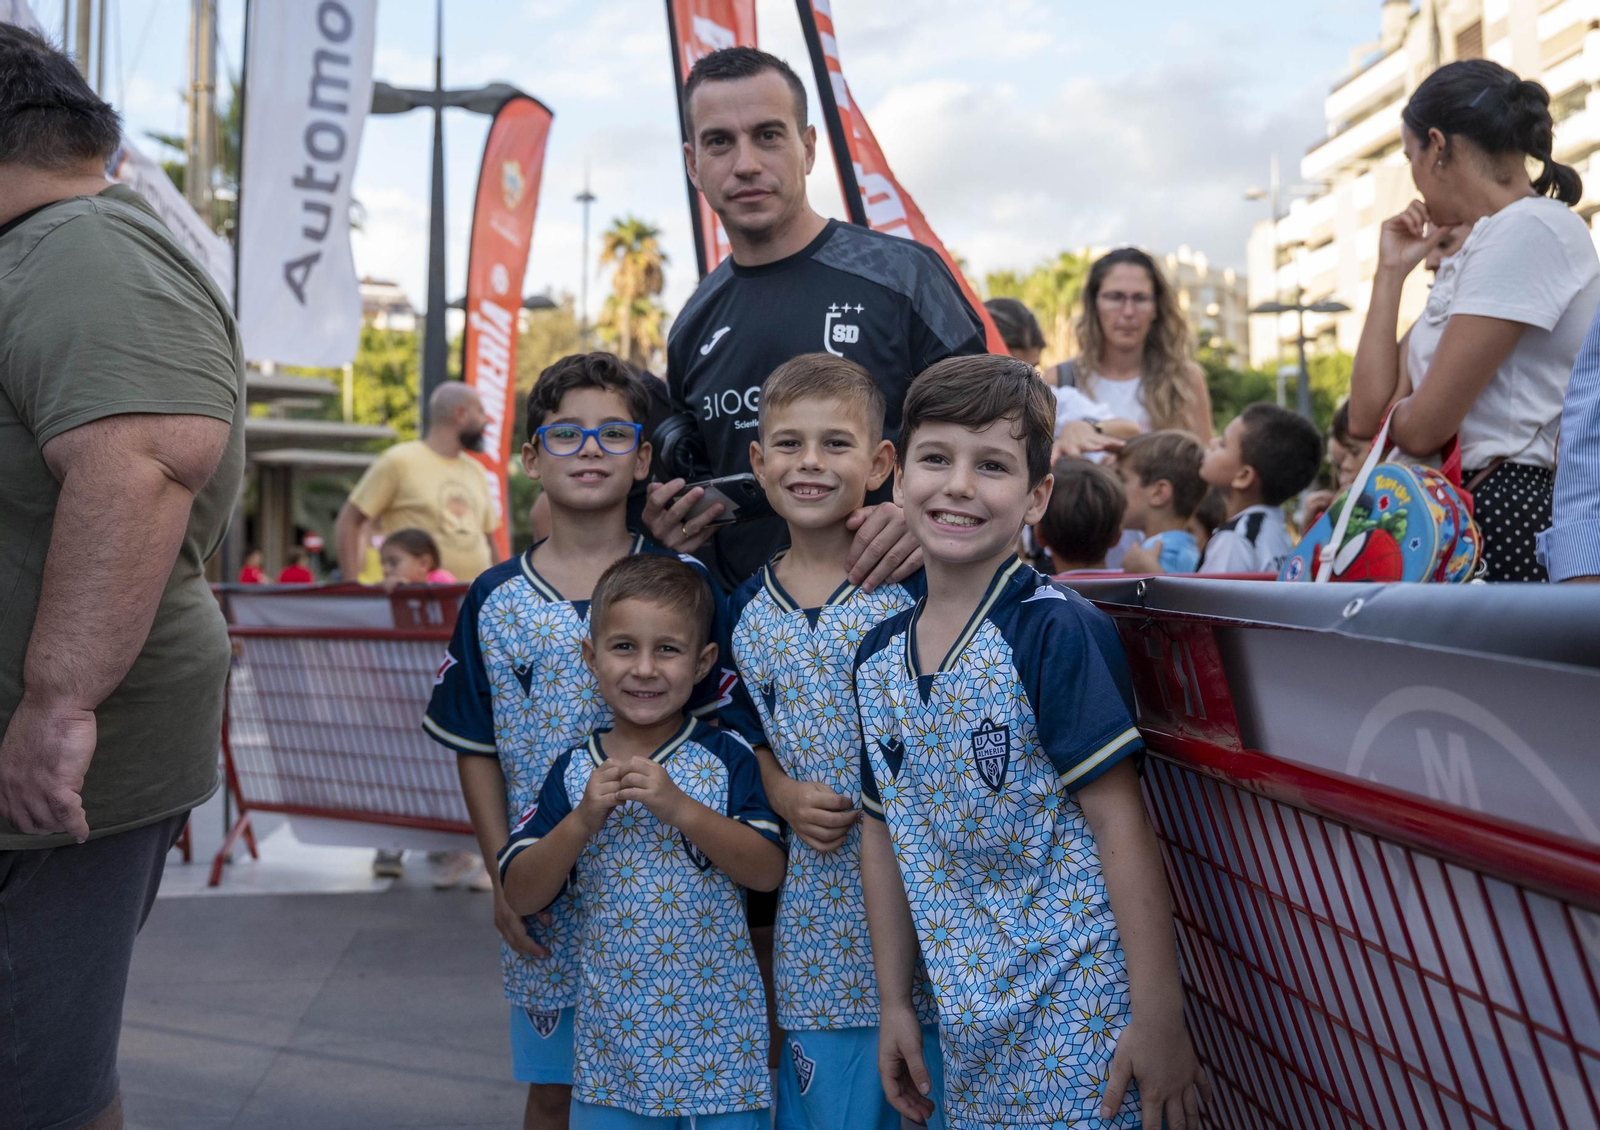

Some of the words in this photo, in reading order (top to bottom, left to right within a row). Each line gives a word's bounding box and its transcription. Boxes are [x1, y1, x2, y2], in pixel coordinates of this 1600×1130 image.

[283, 0, 354, 306] Automo
[832, 323, 860, 344] SD
[978, 747, 1004, 757] ALMERIA
